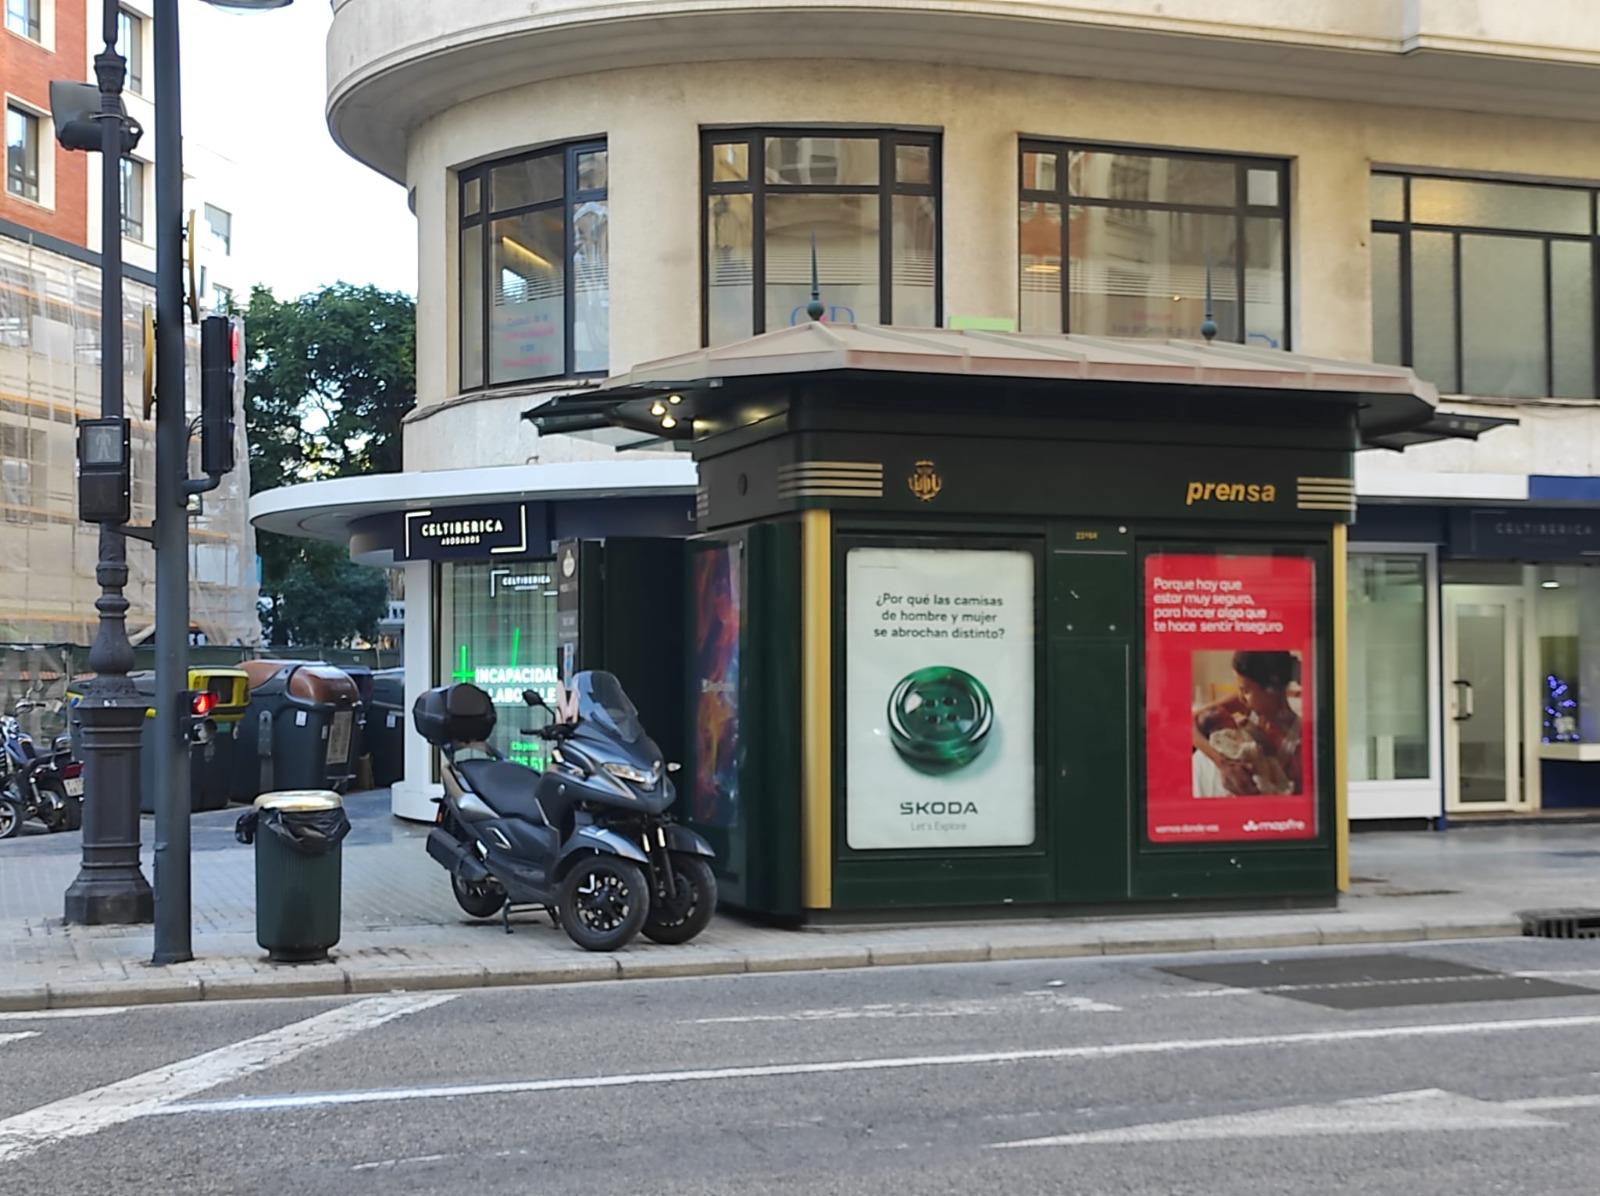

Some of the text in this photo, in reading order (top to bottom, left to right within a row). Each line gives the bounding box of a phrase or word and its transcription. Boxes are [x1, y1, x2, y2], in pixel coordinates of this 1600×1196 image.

[1185, 481, 1276, 506] prensa
[421, 519, 503, 536] CELTIBERICA
[1153, 577, 1242, 593] Porque hay que
[876, 592, 1004, 607] ¿Por qué las camisas
[1153, 593, 1182, 604] estar
[1184, 594, 1211, 606] muy
[881, 610, 998, 625] de hombre y mujer
[1153, 606, 1267, 621] para hacer algo que
[873, 626, 1005, 639] se abrochan distinto?
[1153, 621, 1167, 632] te
[1168, 620, 1197, 632] hace
[1200, 620, 1233, 632] sentir
